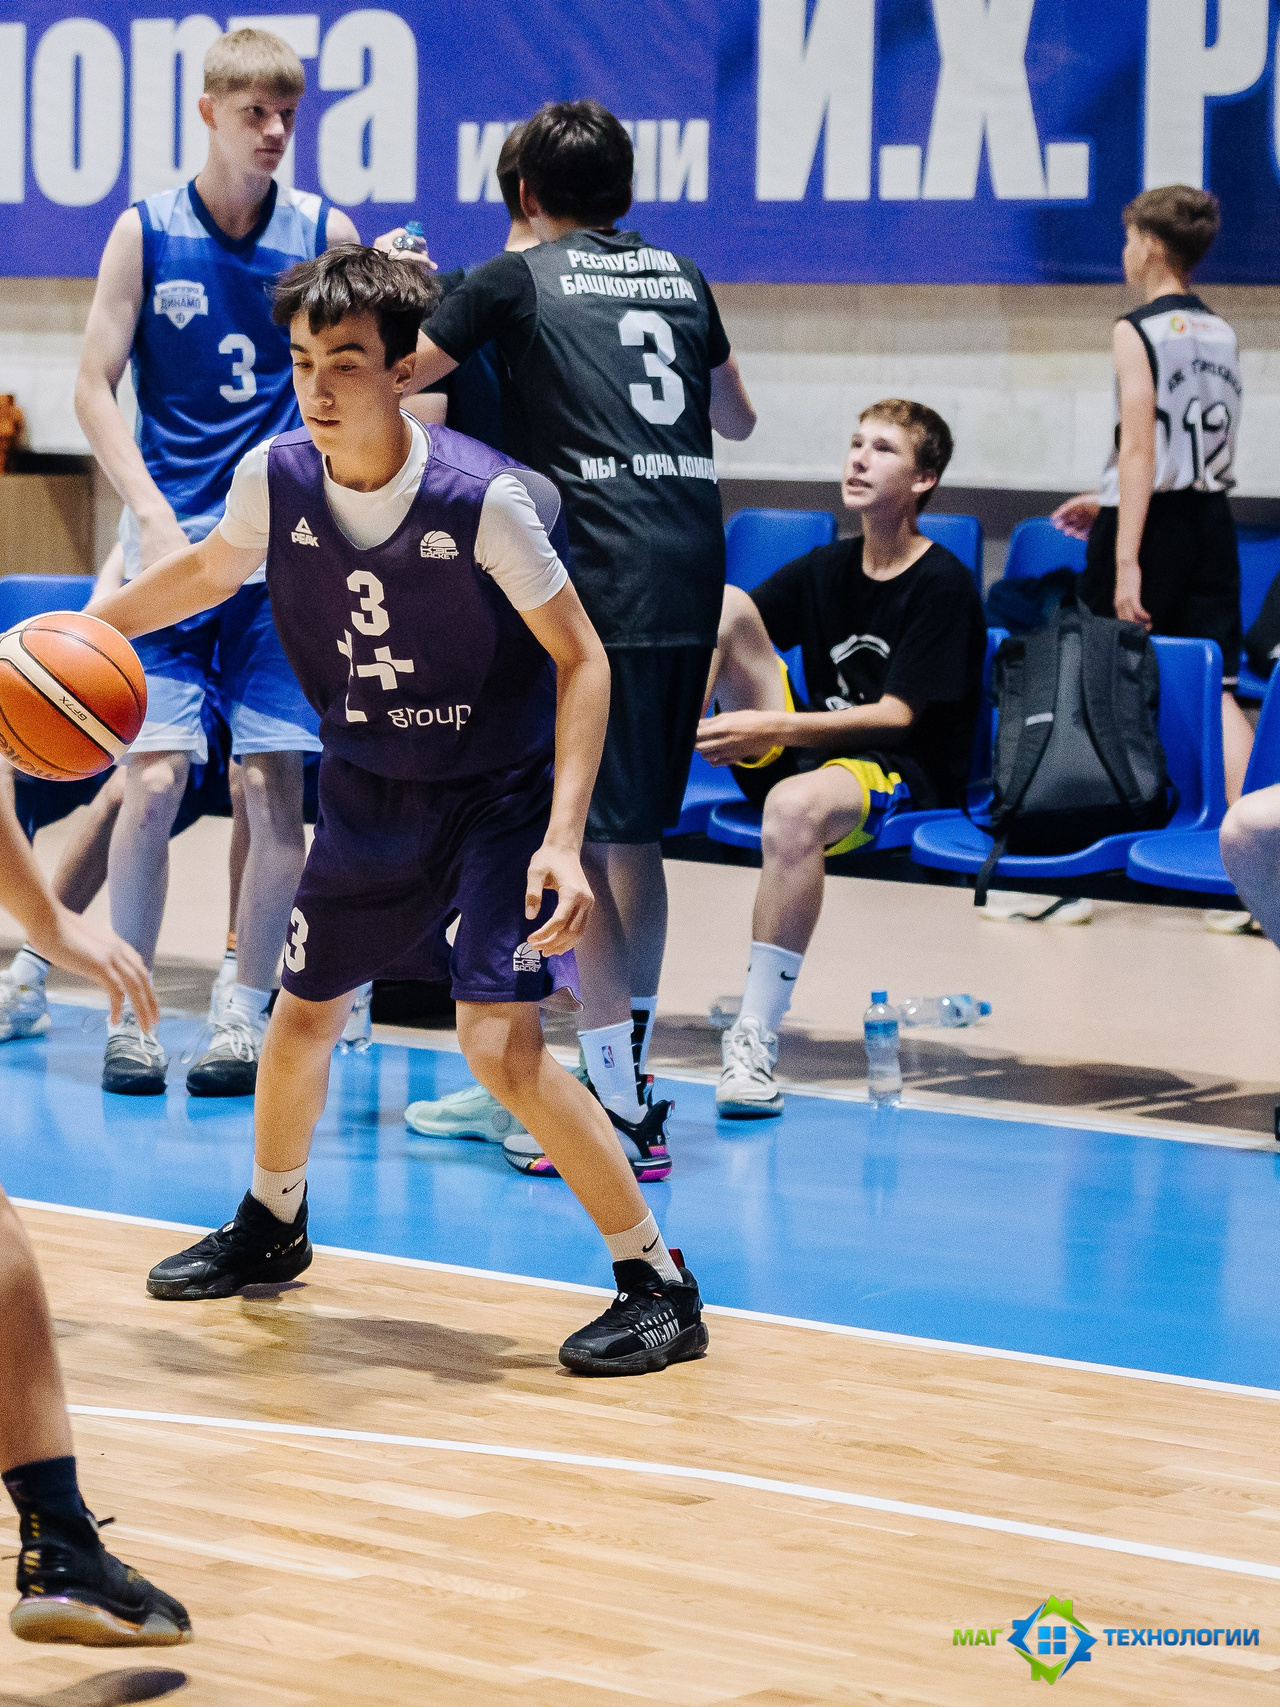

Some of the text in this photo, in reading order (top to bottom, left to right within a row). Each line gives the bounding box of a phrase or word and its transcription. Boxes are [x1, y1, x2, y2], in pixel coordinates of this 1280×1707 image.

[457, 119, 709, 202] ини
[1143, 0, 1280, 192] Р
[567, 248, 680, 272] РЕСПУБЛИКА
[218, 333, 258, 403] 3
[618, 310, 686, 425] 3
[580, 457, 616, 480] МЫ
[632, 454, 678, 479] ОДНА
[1182, 397, 1237, 488] 12
[291, 532, 320, 548] PEAK
[346, 569, 390, 637] 3
[58, 695, 88, 722] GF7X
[386, 703, 472, 731] group
[283, 906, 309, 974] 3
